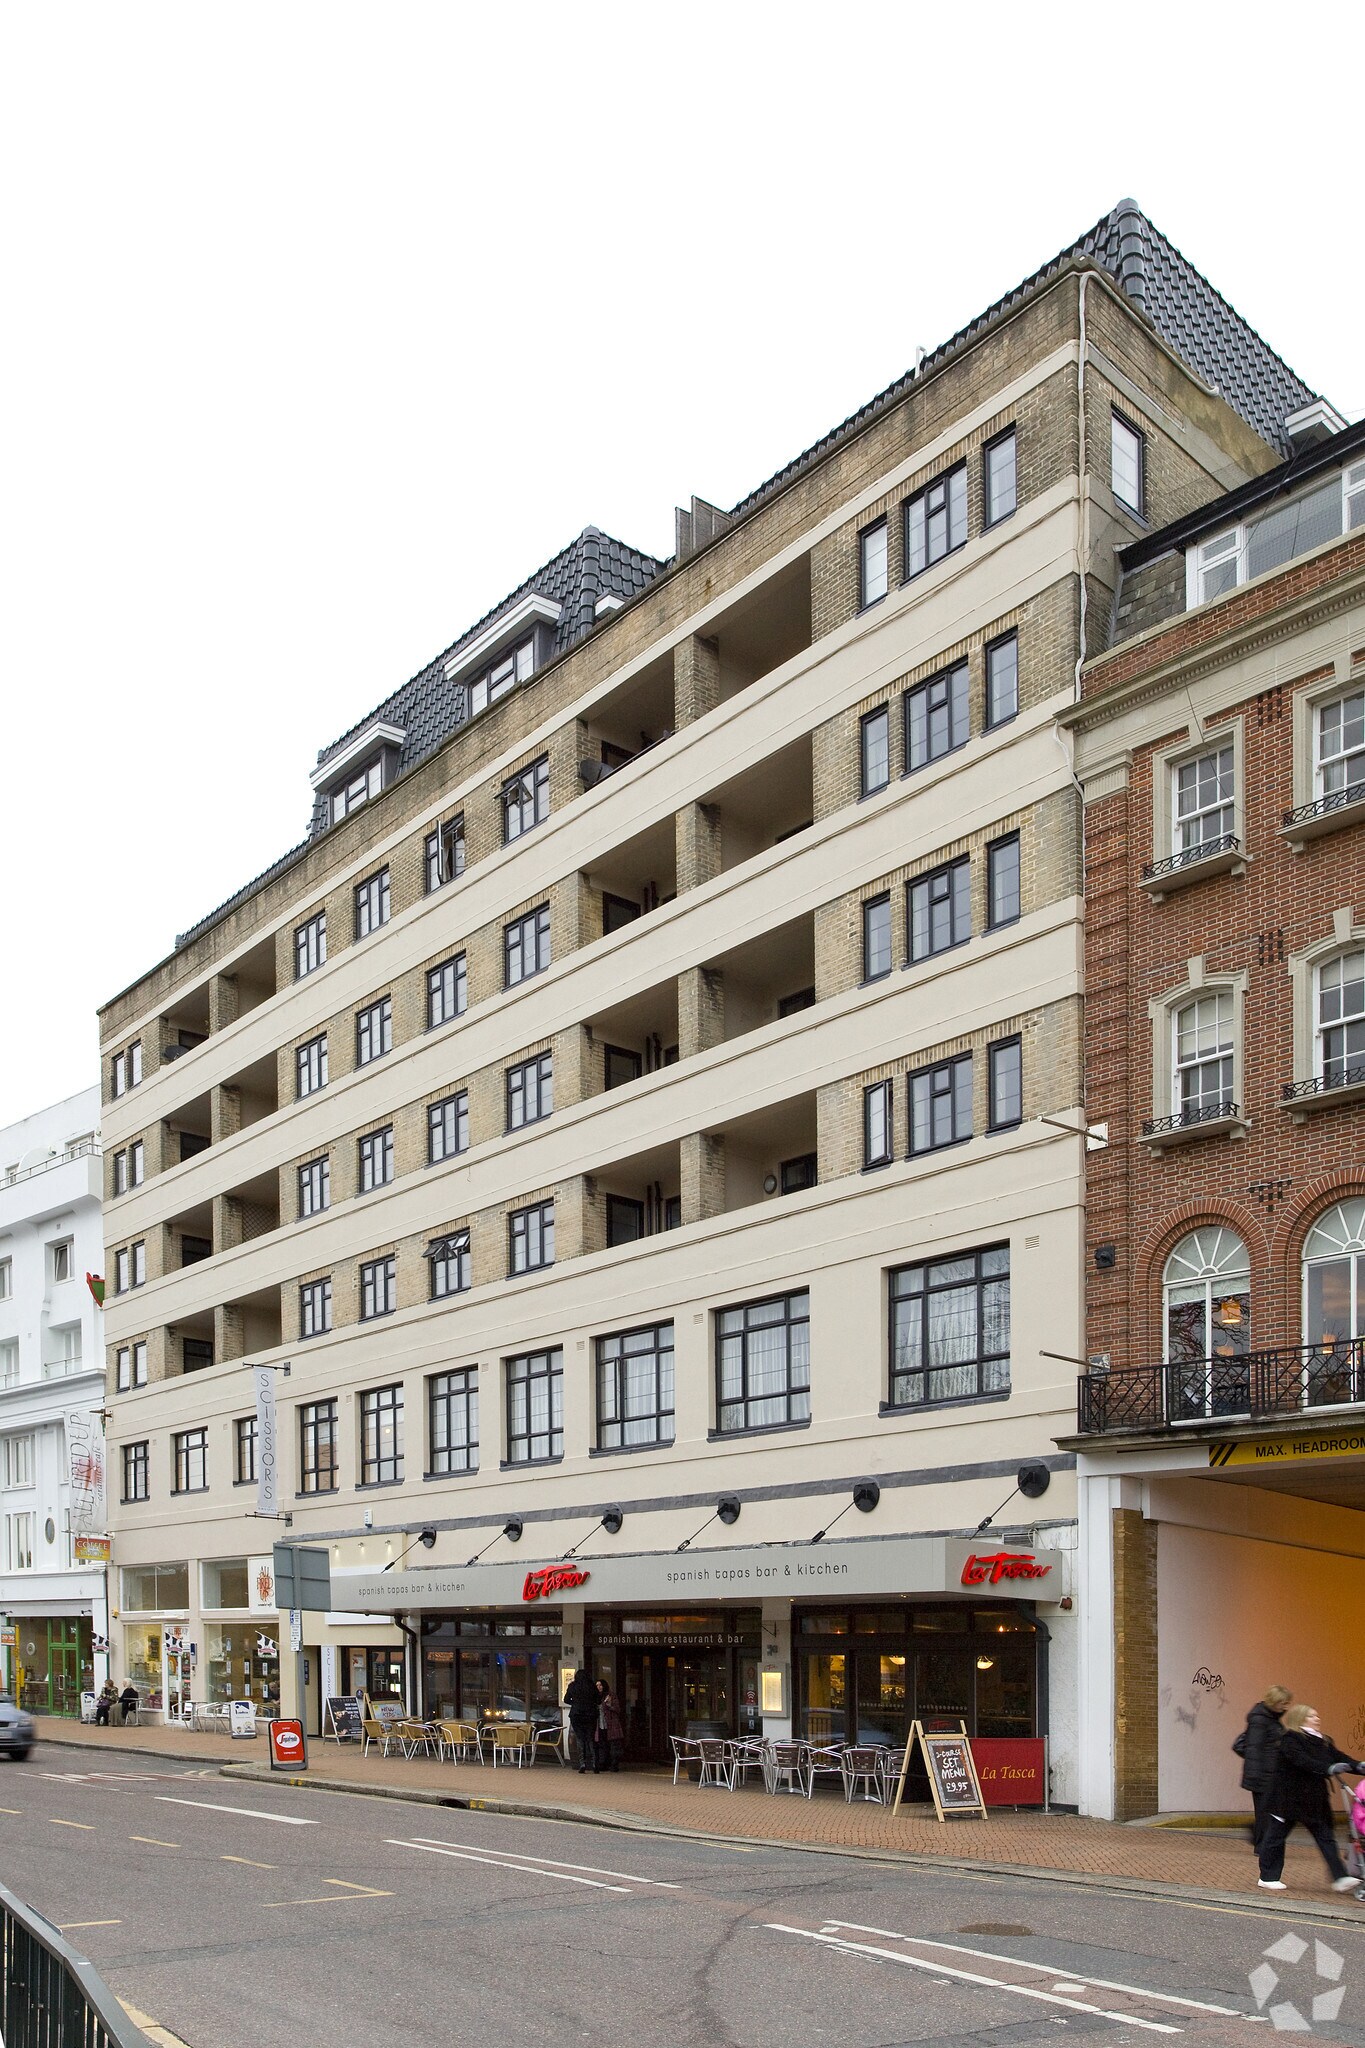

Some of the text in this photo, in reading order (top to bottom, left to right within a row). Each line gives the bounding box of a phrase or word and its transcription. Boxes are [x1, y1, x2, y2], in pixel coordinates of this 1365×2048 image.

[68, 1412, 91, 1441] UP
[260, 1373, 274, 1500] SCISSORS
[1255, 1444, 1287, 1458] MAX.
[70, 1442, 93, 1492] FIRED
[72, 1496, 94, 1528] ALL
[76, 1540, 108, 1550] COFFEE
[667, 1562, 848, 1583] spanish tapas bar & kitchen
[358, 1582, 465, 1597] spanish tapas bar & kitchen
[598, 1634, 744, 1644] spanish tapas restaurant & bar
[942, 1757, 959, 1769] SET
[941, 1767, 966, 1779] MENU
[980, 1765, 1036, 1780] La Tasca
[946, 1781, 969, 1793] £9.95
